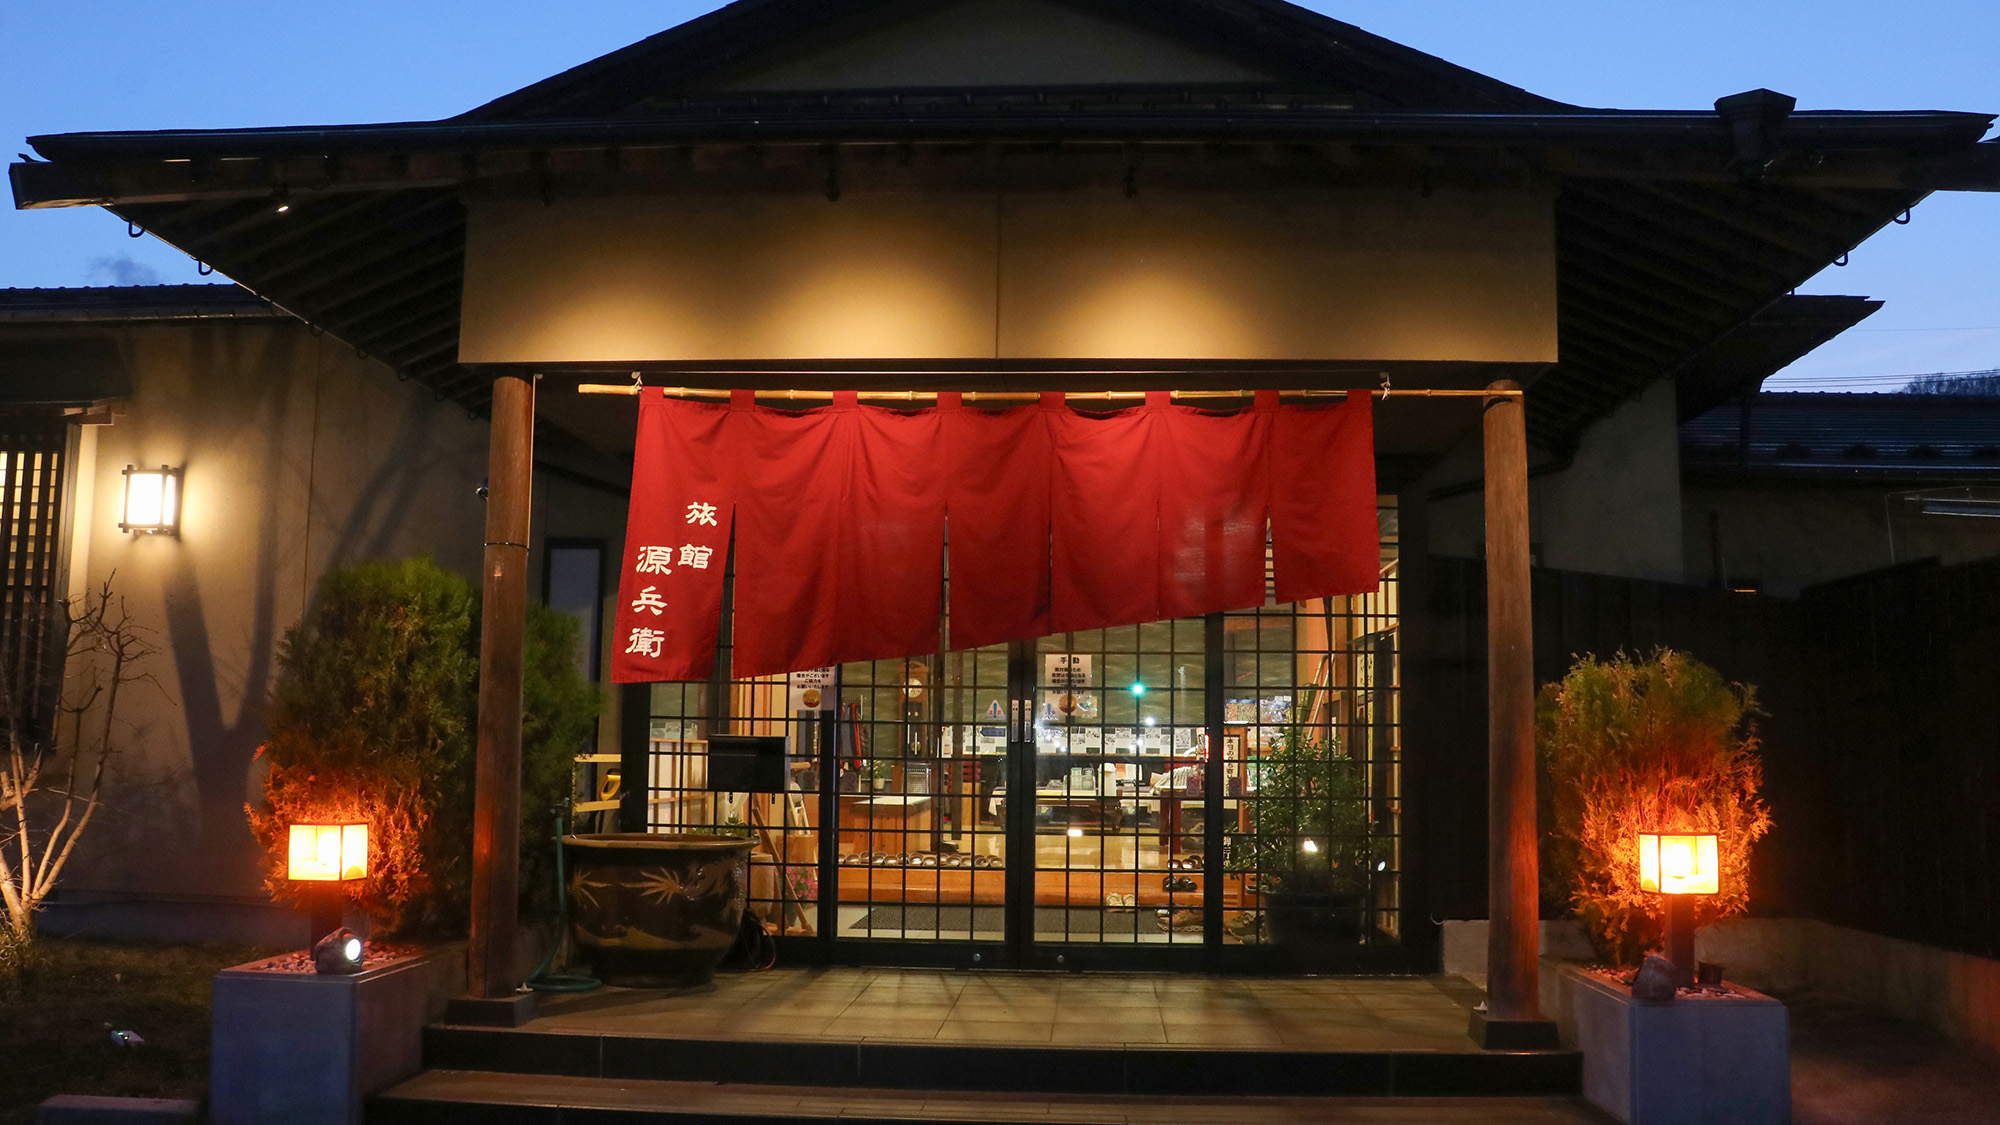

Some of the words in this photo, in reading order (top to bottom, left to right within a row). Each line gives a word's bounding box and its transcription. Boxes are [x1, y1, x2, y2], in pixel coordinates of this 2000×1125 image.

[677, 501, 718, 569] 旅館
[625, 545, 673, 659] 源兵衛
